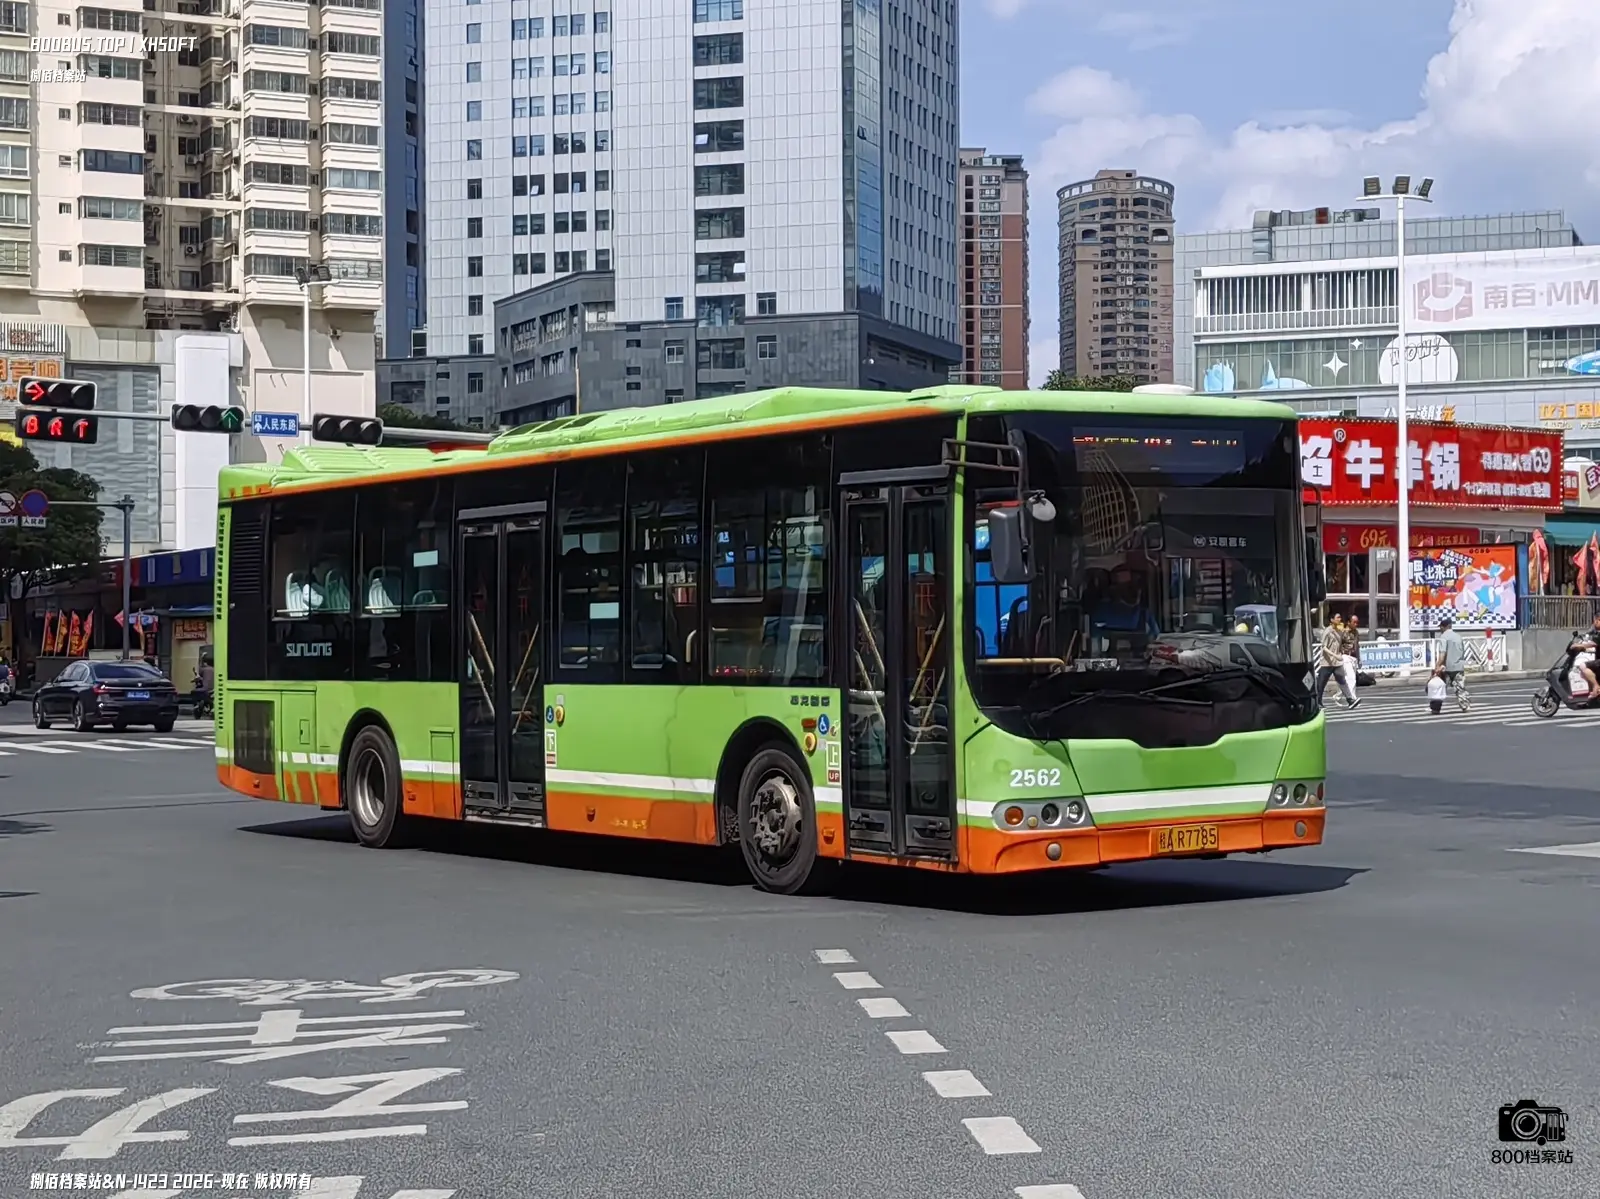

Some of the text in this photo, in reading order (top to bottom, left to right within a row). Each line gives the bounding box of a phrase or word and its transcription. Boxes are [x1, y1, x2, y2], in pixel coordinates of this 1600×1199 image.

[26, 415, 88, 438] BRT
[263, 417, 296, 431] 人民东路
[286, 642, 333, 657] SUNLONG
[829, 745, 839, 766] 上
[1010, 768, 1061, 787] 2562
